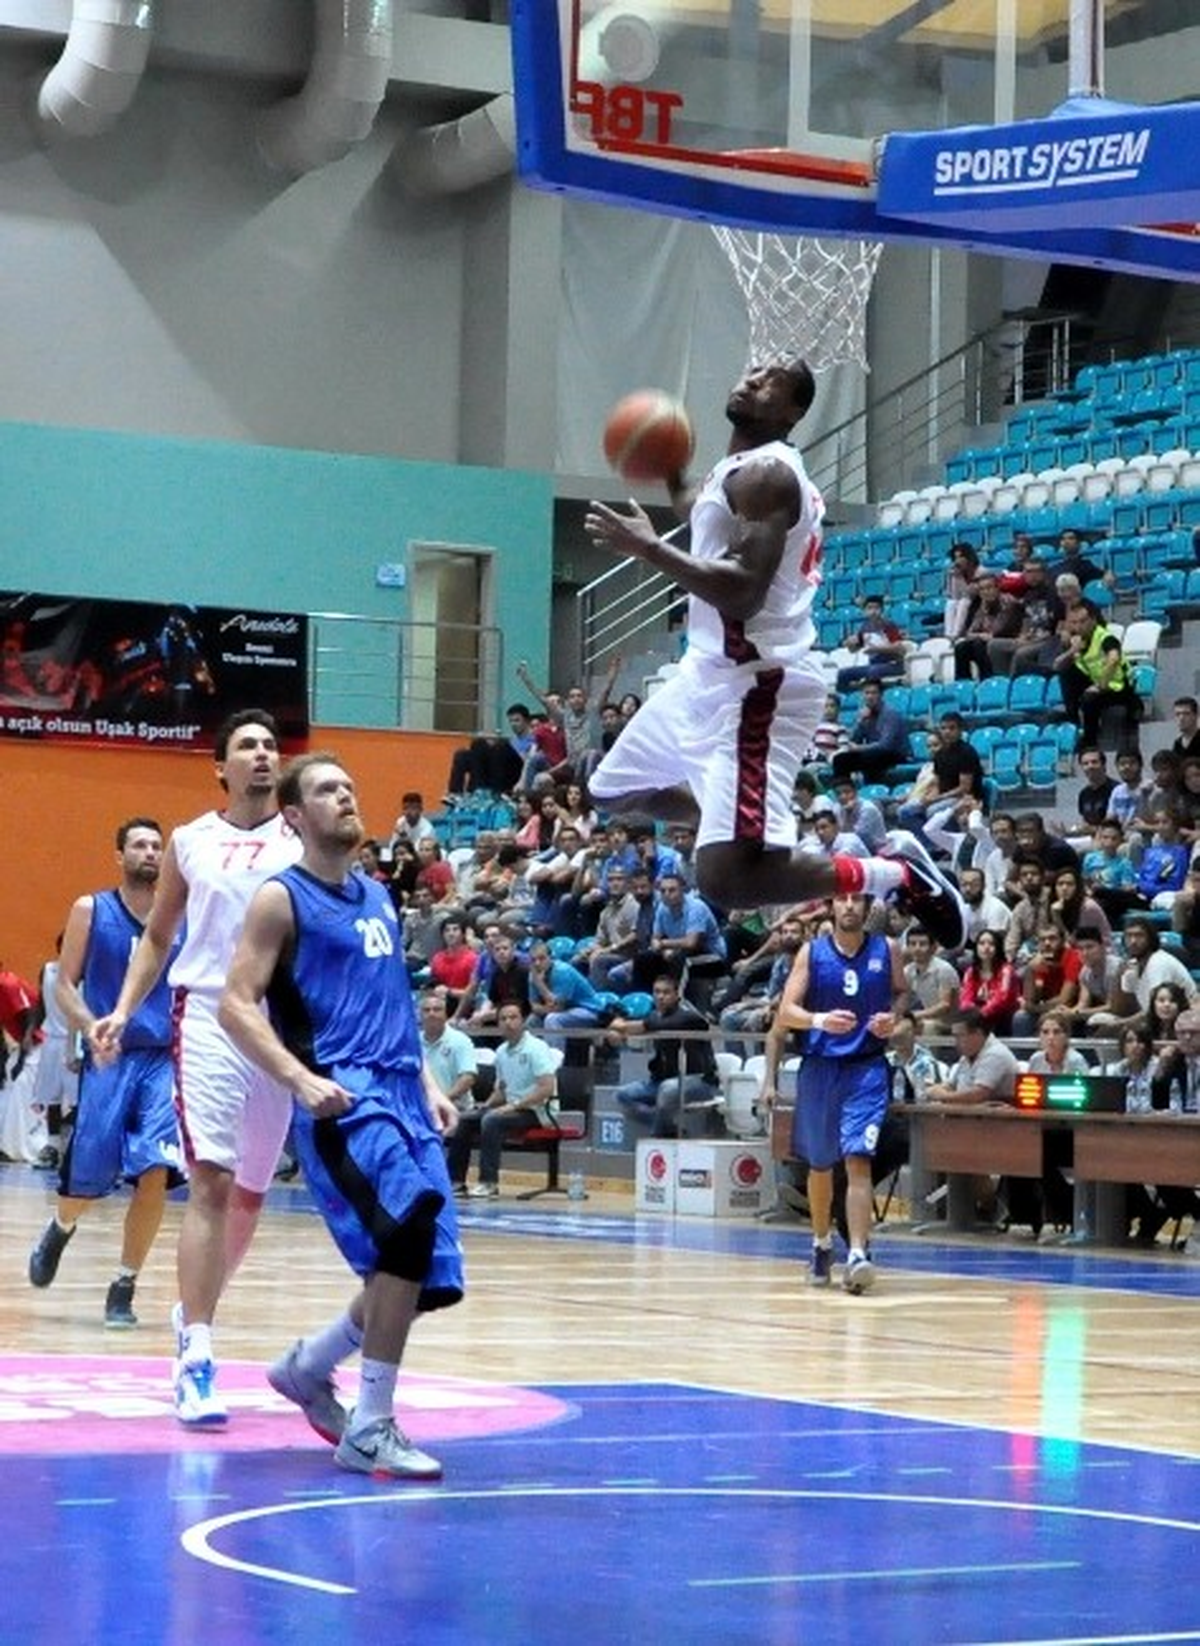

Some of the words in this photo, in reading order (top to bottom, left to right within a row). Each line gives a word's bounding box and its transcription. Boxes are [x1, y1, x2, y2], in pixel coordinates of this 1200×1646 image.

[7, 716, 43, 732] açık
[45, 718, 92, 734] olsun
[95, 719, 135, 738] Uşak
[219, 840, 267, 871] 77
[354, 917, 394, 959] 20
[842, 968, 859, 997] 9
